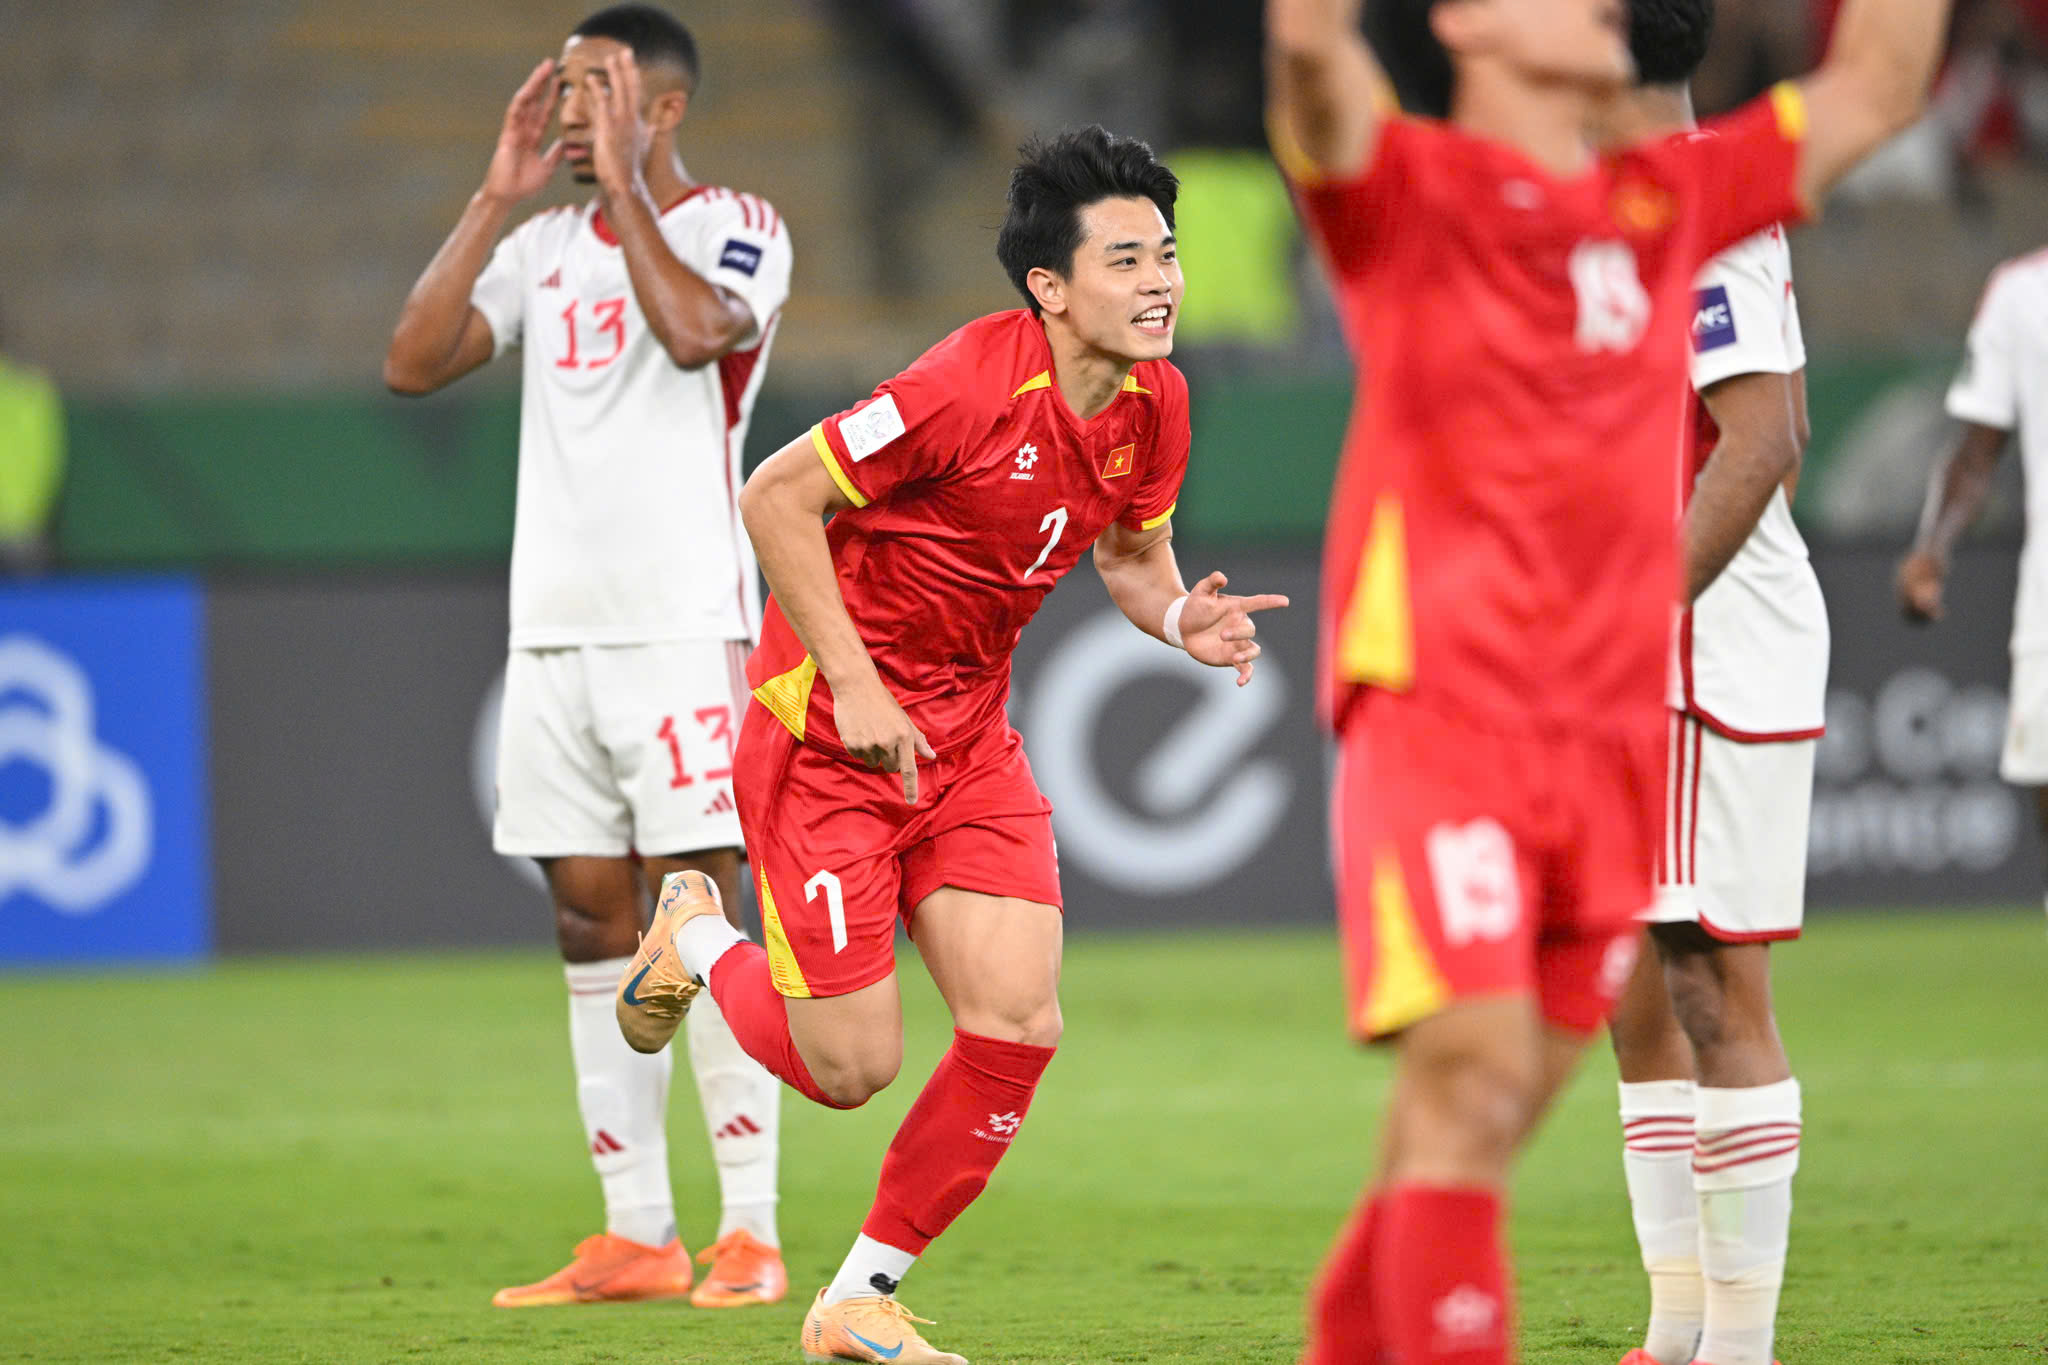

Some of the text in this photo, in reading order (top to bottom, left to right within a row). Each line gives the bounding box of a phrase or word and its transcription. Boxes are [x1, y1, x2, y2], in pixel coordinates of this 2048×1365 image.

[555, 298, 626, 370] 13
[1023, 506, 1069, 581] 7
[656, 704, 733, 790] 13
[803, 869, 849, 956] 7
